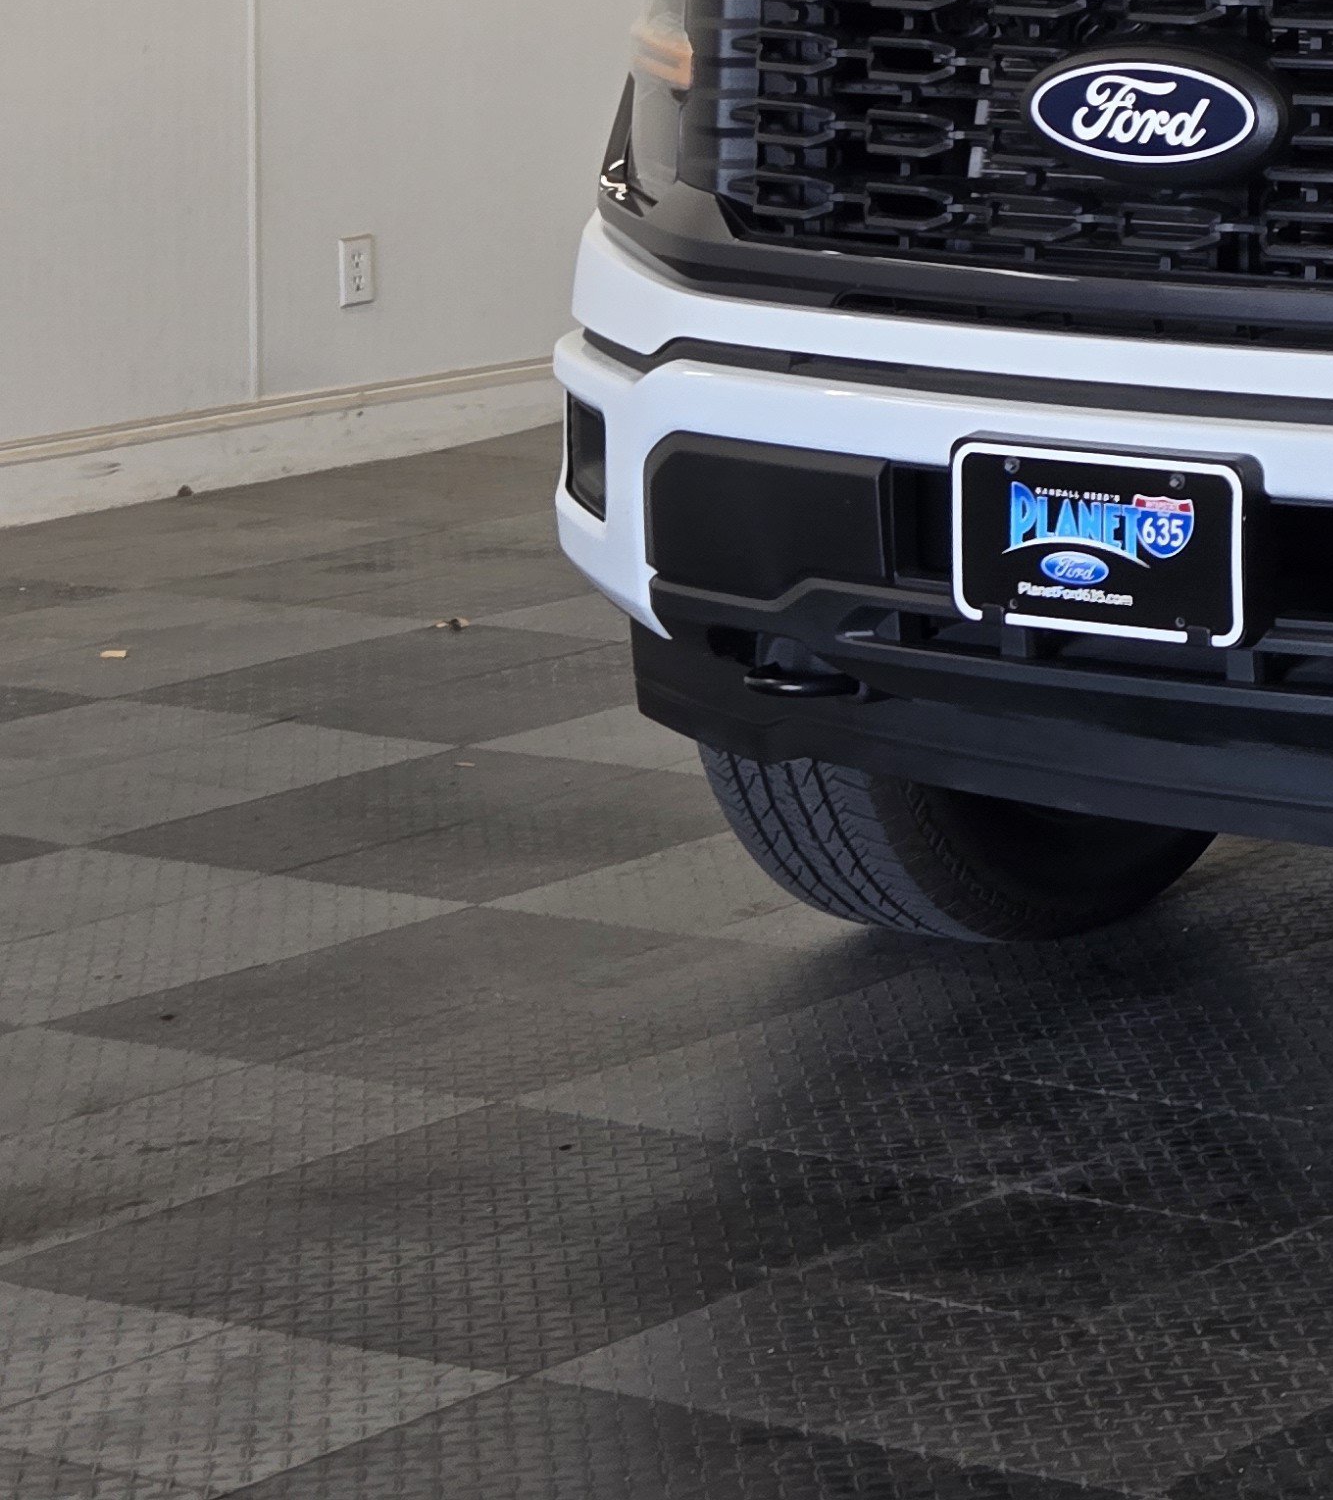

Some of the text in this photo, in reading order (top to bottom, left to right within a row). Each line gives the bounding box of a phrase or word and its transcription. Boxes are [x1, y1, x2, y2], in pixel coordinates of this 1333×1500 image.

[1071, 74, 1211, 147] Ford
[1010, 481, 1144, 560] PLANET
[1143, 517, 1184, 548] 635
[1055, 558, 1096, 581] Ford
